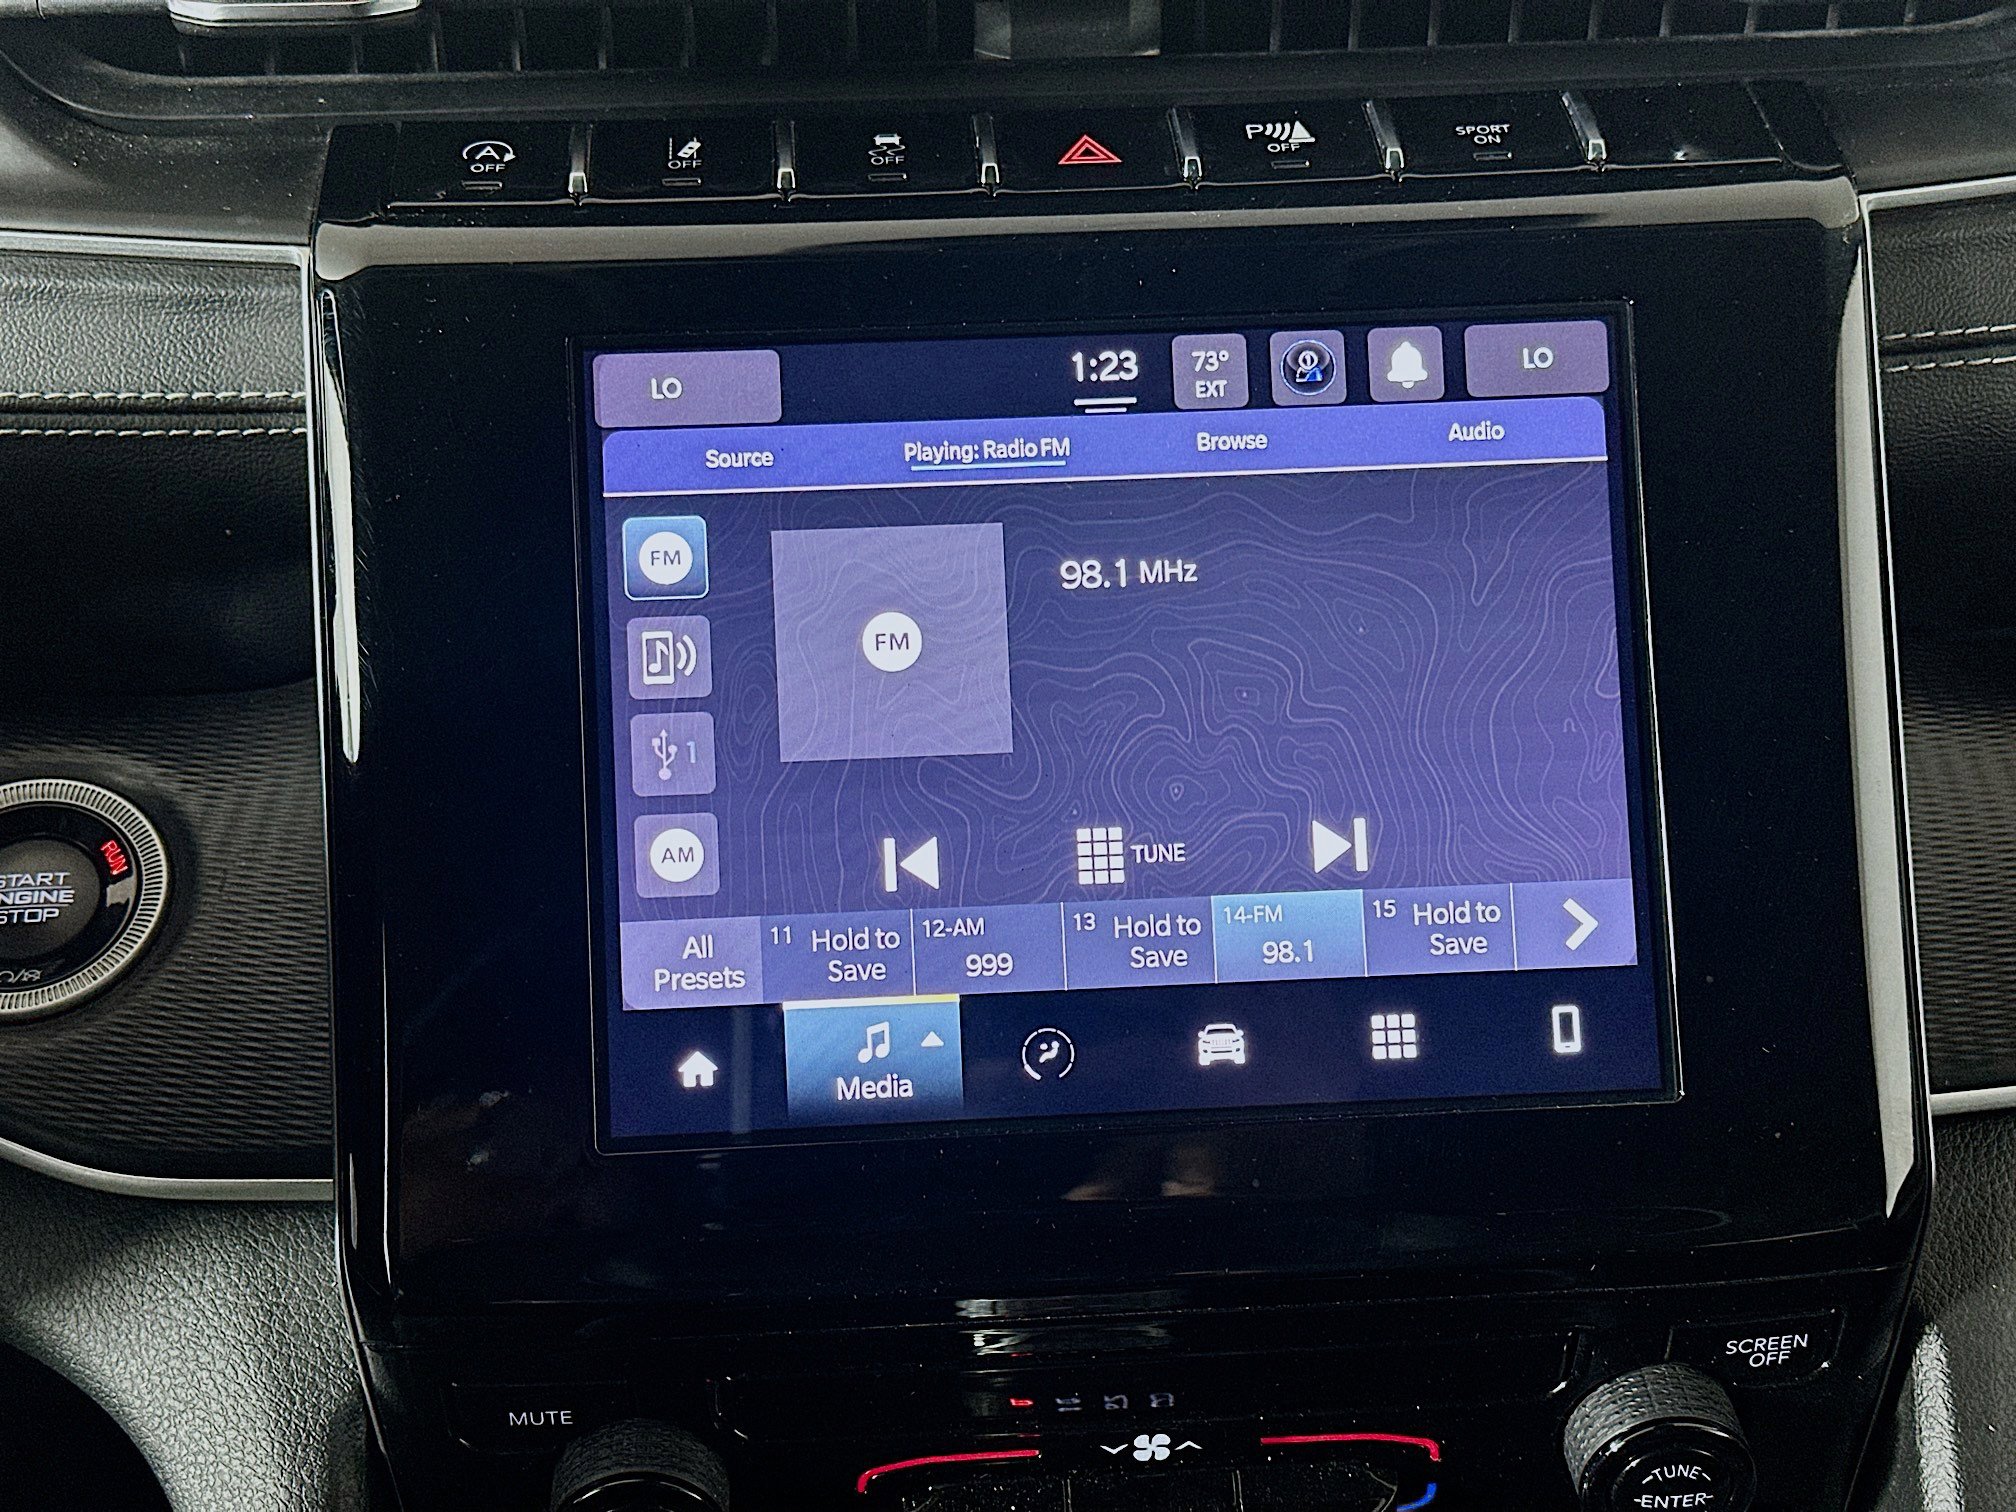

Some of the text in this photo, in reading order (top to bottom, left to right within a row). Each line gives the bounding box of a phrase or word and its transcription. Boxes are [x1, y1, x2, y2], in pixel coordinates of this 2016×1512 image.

[1455, 123, 1510, 136] SPORT
[1473, 133, 1500, 145] ON
[1267, 142, 1300, 153] OFF
[470, 163, 506, 173] OFF
[668, 160, 702, 169] OFF
[871, 155, 905, 165] OFF
[1071, 350, 1140, 383] 1:23
[1190, 349, 1231, 373] 73°
[1522, 347, 1555, 370] LO
[650, 377, 683, 401] LO
[1194, 379, 1228, 399] EXT
[1196, 431, 1268, 453] Browse
[1448, 420, 1506, 443] Audio
[705, 448, 774, 470] Source
[904, 437, 1071, 466] Playing: Radio FM
[650, 549, 682, 567] FM
[1059, 558, 1199, 590] 98.1 MHz
[874, 632, 910, 651] FM
[686, 741, 697, 764] 1
[100, 840, 129, 875] RUN
[661, 847, 695, 864] AM
[1130, 843, 1186, 864] TUNE
[0, 890, 75, 905] NGINE
[1223, 905, 1284, 925] 14-FM
[1373, 899, 1397, 919] 15
[1412, 900, 1501, 926] Hold to
[922, 917, 986, 938] 12-AM
[1073, 912, 1096, 932] 13
[1113, 914, 1201, 939] Hold to
[771, 925, 792, 946] 11
[811, 926, 901, 953] Hold to
[1428, 932, 1488, 956] Save
[683, 935, 713, 960] All
[1129, 945, 1189, 968] Save
[1261, 940, 1315, 965] 98.1
[827, 958, 887, 983] Save
[965, 953, 1014, 977] 999
[654, 967, 746, 991] Presets
[836, 1074, 914, 1101] Media
[1725, 1333, 1809, 1356] SCREEN
[1748, 1350, 1792, 1368] OFF
[508, 1411, 574, 1426] MUTE
[1651, 1464, 1702, 1482] TUNE
[1640, 1491, 1709, 1509] ENTER
